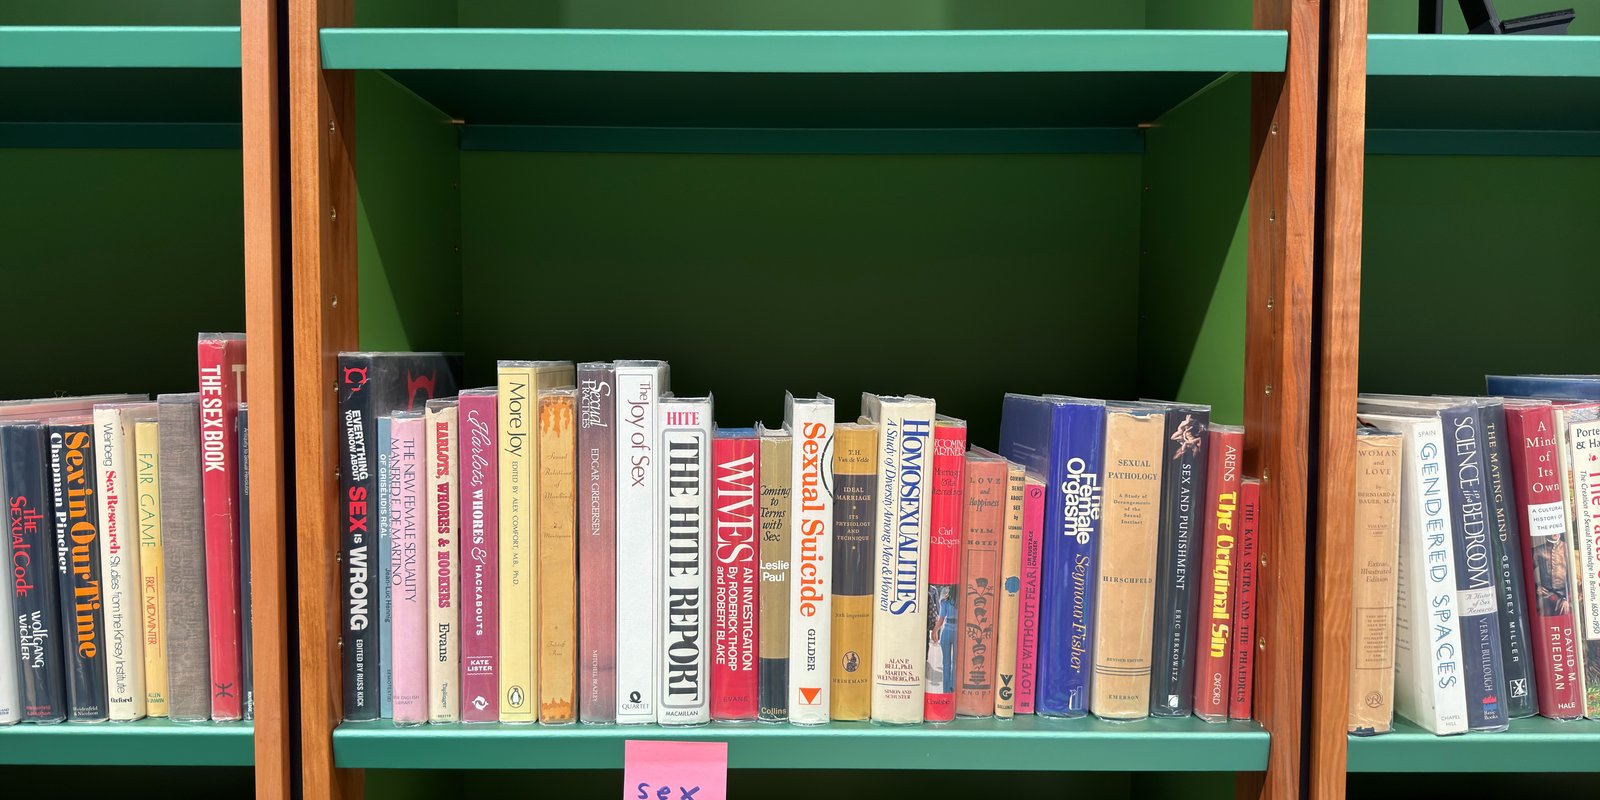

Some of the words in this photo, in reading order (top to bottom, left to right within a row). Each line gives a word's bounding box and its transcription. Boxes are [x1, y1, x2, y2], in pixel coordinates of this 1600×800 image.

[201, 365, 222, 396] THE
[640, 382, 652, 400] The
[202, 398, 224, 428] SEX
[509, 382, 526, 428] More
[590, 381, 611, 428] Sexual
[625, 400, 649, 428] Joy
[667, 412, 700, 426] HITE
[888, 418, 896, 426] A
[1488, 424, 1496, 448] THE
[1538, 421, 1546, 432] A
[103, 422, 112, 466] Weinberg
[204, 430, 224, 472] BOOK
[347, 428, 356, 452] KNOW
[352, 410, 368, 480] EVERYTHING
[404, 438, 414, 460] THE
[436, 422, 449, 480] HARLOTS,
[468, 409, 491, 486] Harlots,
[505, 430, 526, 457] Joy
[631, 432, 650, 450] of
[884, 429, 898, 453] Study
[1454, 416, 1480, 489] SCIENCE
[1526, 435, 1556, 448] Mind
[1539, 452, 1551, 462] of
[64, 432, 90, 484] Sex
[138, 454, 154, 484] FAIR
[350, 454, 360, 481] ABOUT
[591, 448, 599, 480] EDGAR
[631, 456, 650, 486] Sex
[669, 436, 699, 498] THE
[802, 422, 826, 512] Sexual
[886, 456, 896, 470] of
[1182, 464, 1191, 484] SEX
[1224, 445, 1236, 482] ARENS
[1538, 467, 1554, 478] Its
[106, 470, 116, 493] Sex
[404, 464, 416, 493] NEW
[760, 485, 791, 498] Coming
[884, 472, 896, 508] Diversity
[1108, 472, 1158, 480] PATHOLOGY
[1490, 453, 1502, 502] MATING
[1532, 482, 1559, 493] Own
[50, 432, 62, 508] Chapman
[56, 511, 66, 574] Pincher
[68, 488, 92, 518] in
[349, 486, 368, 533] SEX
[437, 482, 450, 534] WHORES
[592, 482, 600, 535] GREGERSEN
[716, 452, 754, 564] WIVES
[969, 497, 999, 512] Happiness
[1062, 458, 1085, 536] Orgasm
[1076, 472, 1096, 544] Female
[1180, 488, 1190, 512] AND
[1217, 491, 1237, 531] The
[1463, 490, 1472, 502] the
[1473, 490, 1480, 498] in
[107, 495, 120, 554] Research
[141, 494, 156, 548] GAME
[404, 496, 416, 540] FEMALE
[472, 488, 484, 544] WHORES
[761, 508, 786, 517] Terms
[762, 520, 782, 530] with
[881, 509, 894, 545] Among
[890, 420, 930, 616] HOMOSEXUALITIES
[1245, 503, 1254, 520] THE
[1420, 442, 1447, 582] GENDERED
[1497, 508, 1508, 542] MIND
[354, 534, 362, 544] IS
[438, 538, 450, 548] &
[669, 505, 699, 578] HITE
[764, 531, 780, 542] Sex
[938, 527, 952, 535] Carl
[1244, 528, 1253, 556] KAMA
[1462, 502, 1490, 588] BEDROOM
[70, 521, 96, 580] Our
[471, 546, 486, 564] &
[760, 560, 790, 570] Leslie
[883, 546, 893, 566] Men
[1176, 514, 1188, 590] PUNISHMENT
[110, 556, 120, 590] Studies
[146, 576, 156, 594] ERIC
[405, 542, 416, 602] SEXUALITY
[438, 550, 450, 608] HOOKERS
[716, 568, 725, 584] and
[728, 567, 738, 579] By
[744, 568, 753, 584] AN
[763, 572, 784, 582] Paul
[800, 519, 824, 617] Suicide
[883, 566, 892, 574] &
[1026, 570, 1036, 600] FEAR
[1212, 534, 1234, 620] Original
[1242, 562, 1251, 594] SUTRA
[112, 592, 122, 614] from
[350, 546, 368, 630] WRONG
[475, 565, 483, 636] HACKABOUTS
[880, 576, 892, 612] Women
[1072, 554, 1090, 624] Seymour
[74, 580, 100, 658] Time
[114, 614, 122, 628] the
[146, 596, 157, 645] MIDWINTER
[717, 587, 726, 628] ROBERT
[728, 582, 737, 634] RODERICK
[1502, 556, 1514, 614] GEOFFREY
[1509, 622, 1518, 662] MILLER
[114, 630, 124, 659] Kinsey
[439, 622, 450, 662] Evans
[668, 586, 700, 701] REPORT
[742, 587, 752, 671] INVESTIGATION
[1023, 602, 1035, 662] WITHOUT
[1210, 622, 1230, 658] Sin
[1240, 624, 1248, 644] THE
[1432, 594, 1456, 688] SPACES
[716, 630, 725, 664] BLAKE
[728, 636, 737, 671] THORP
[807, 628, 816, 671] GILDER
[1071, 622, 1086, 674] Fisher
[1172, 632, 1180, 681] BERKOWITZ
[1550, 626, 1564, 690] FRIEDMAN
[1564, 628, 1575, 668] DAVID
[116, 660, 126, 694] Institute
[1022, 663, 1032, 695] LOVE
[1212, 672, 1222, 705] OXFORD
[1238, 651, 1248, 703] PHAEDRUS
[1568, 672, 1576, 686] M.
[638, 783, 700, 800] sex
